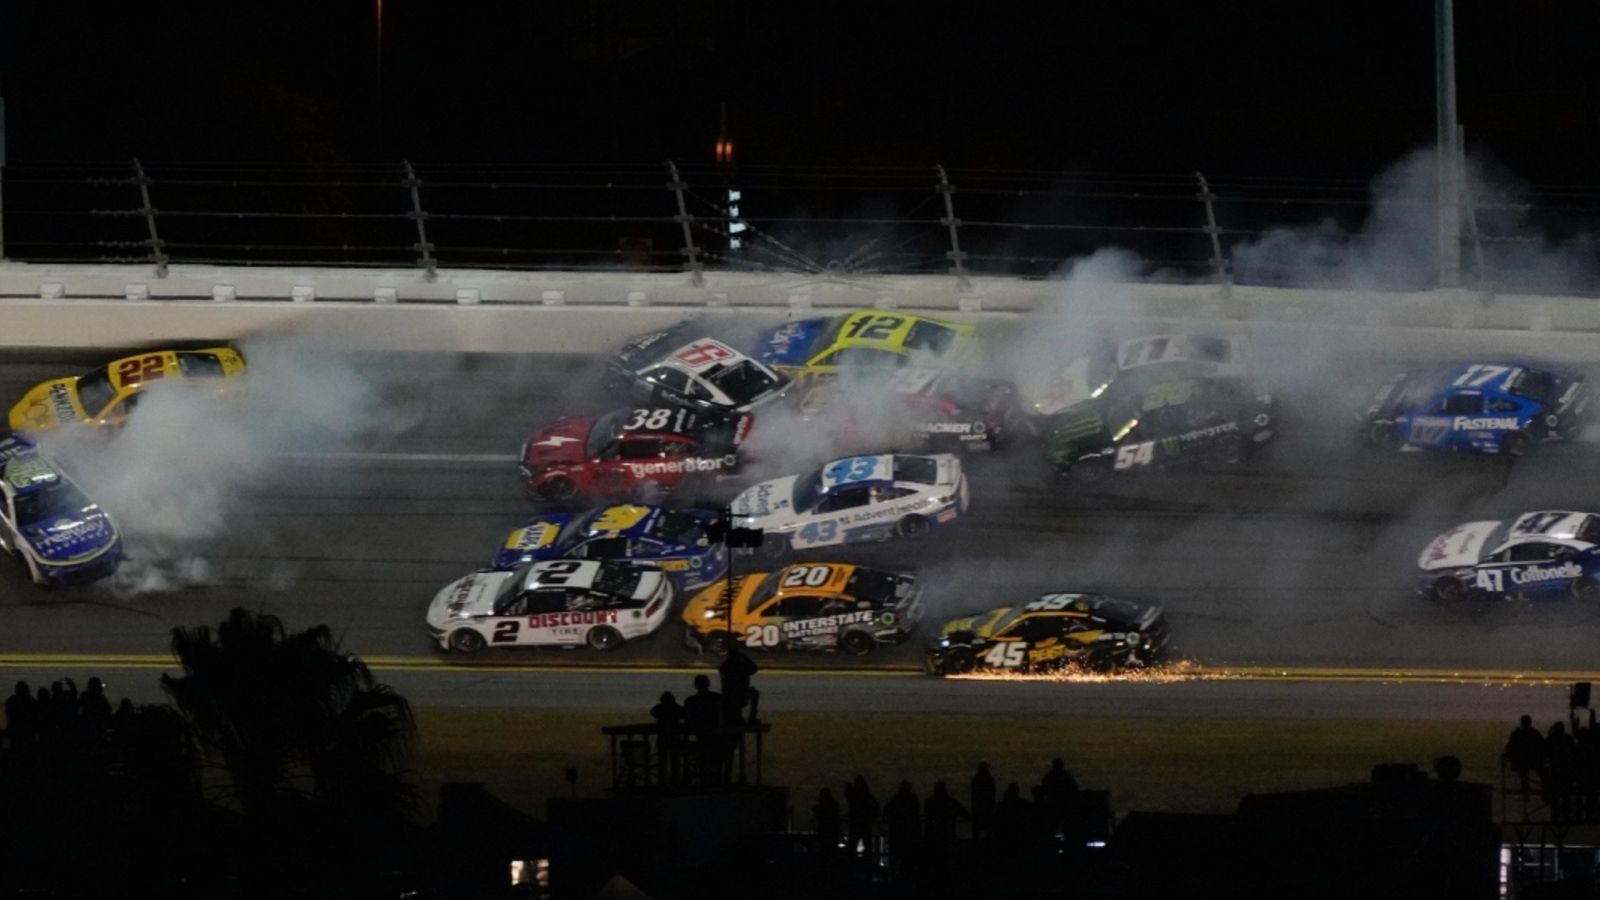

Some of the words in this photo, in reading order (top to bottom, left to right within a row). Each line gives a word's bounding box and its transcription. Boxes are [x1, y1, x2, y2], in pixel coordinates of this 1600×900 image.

[845, 315, 904, 340] 12
[675, 342, 731, 366] 6
[119, 355, 164, 387] 22
[1453, 364, 1508, 387] 17
[623, 408, 672, 431] 38
[1114, 441, 1155, 469] 54
[630, 457, 723, 479] gener8tor
[826, 457, 878, 484] 43
[798, 519, 839, 543] 43
[1516, 511, 1572, 534] 47
[538, 561, 581, 585] 2
[784, 566, 831, 588] 20
[1476, 569, 1504, 592] 47
[1511, 562, 1583, 584] Cottonelle
[1026, 593, 1082, 610] 45
[528, 610, 619, 629] DISCOUNT
[783, 610, 874, 632] INTERSTATE
[492, 620, 521, 643] 2
[745, 624, 780, 647] 20
[985, 641, 1027, 667] 45
